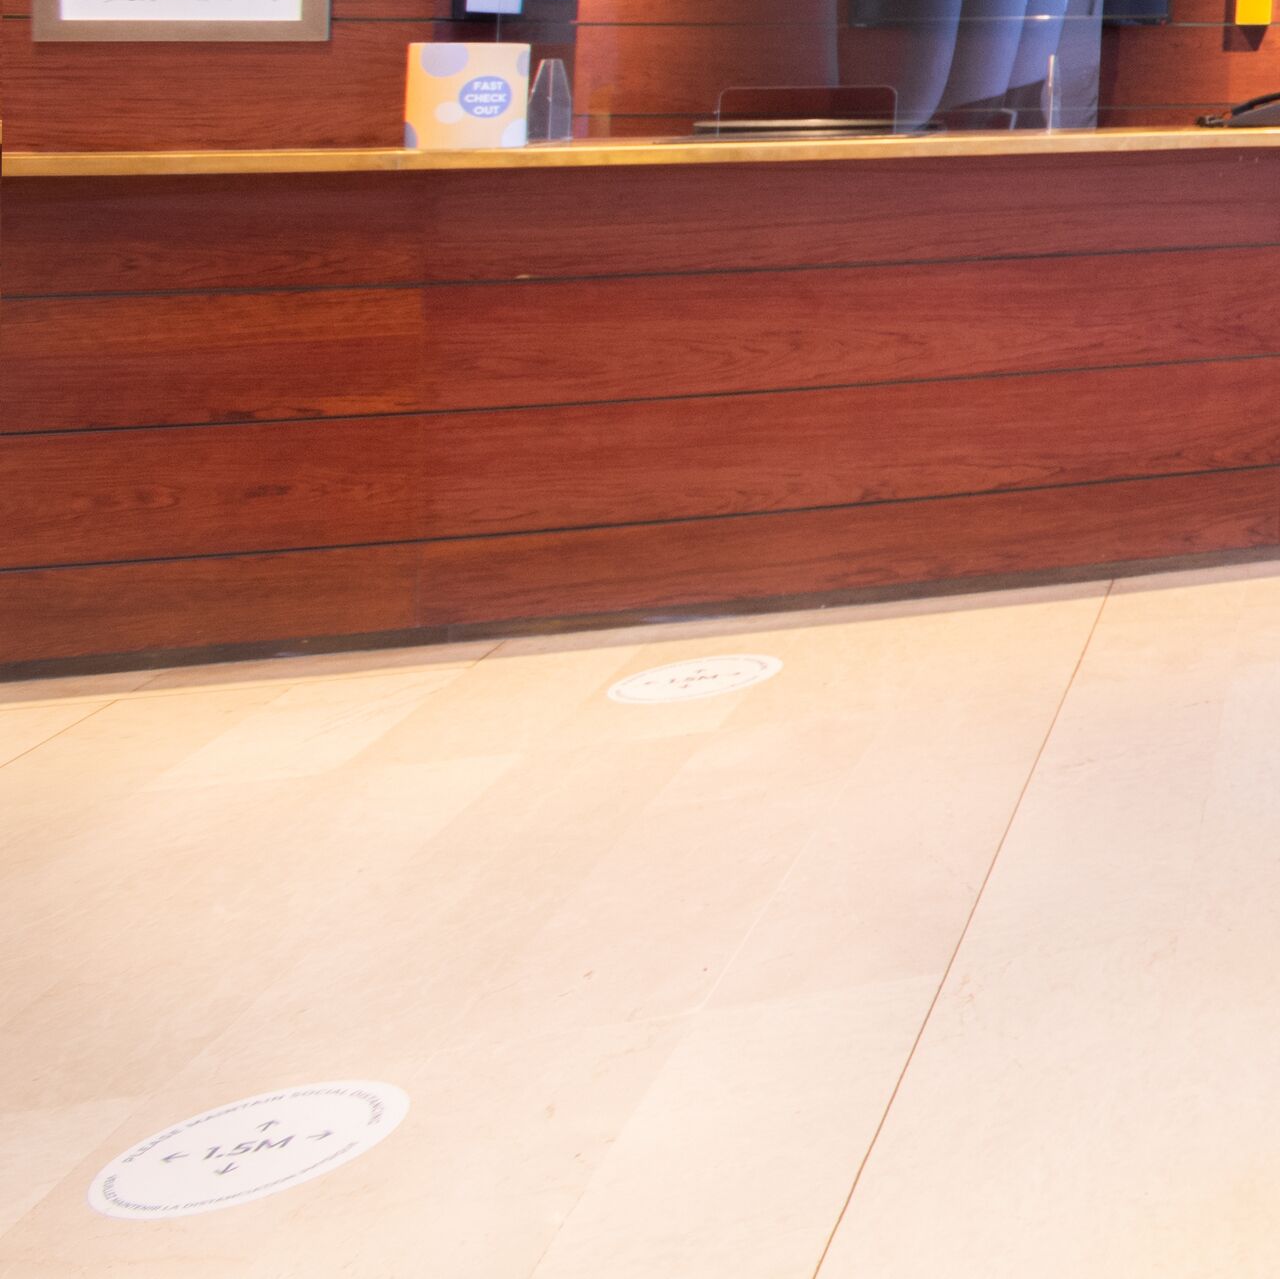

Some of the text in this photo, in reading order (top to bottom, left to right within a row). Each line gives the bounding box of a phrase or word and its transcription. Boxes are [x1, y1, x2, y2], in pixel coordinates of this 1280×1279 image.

[473, 81, 504, 91] FAST
[464, 93, 508, 104] CHECK
[473, 105, 500, 116] OUT
[289, 1087, 348, 1099] SOCIAL
[202, 1134, 296, 1161] 1.5M
